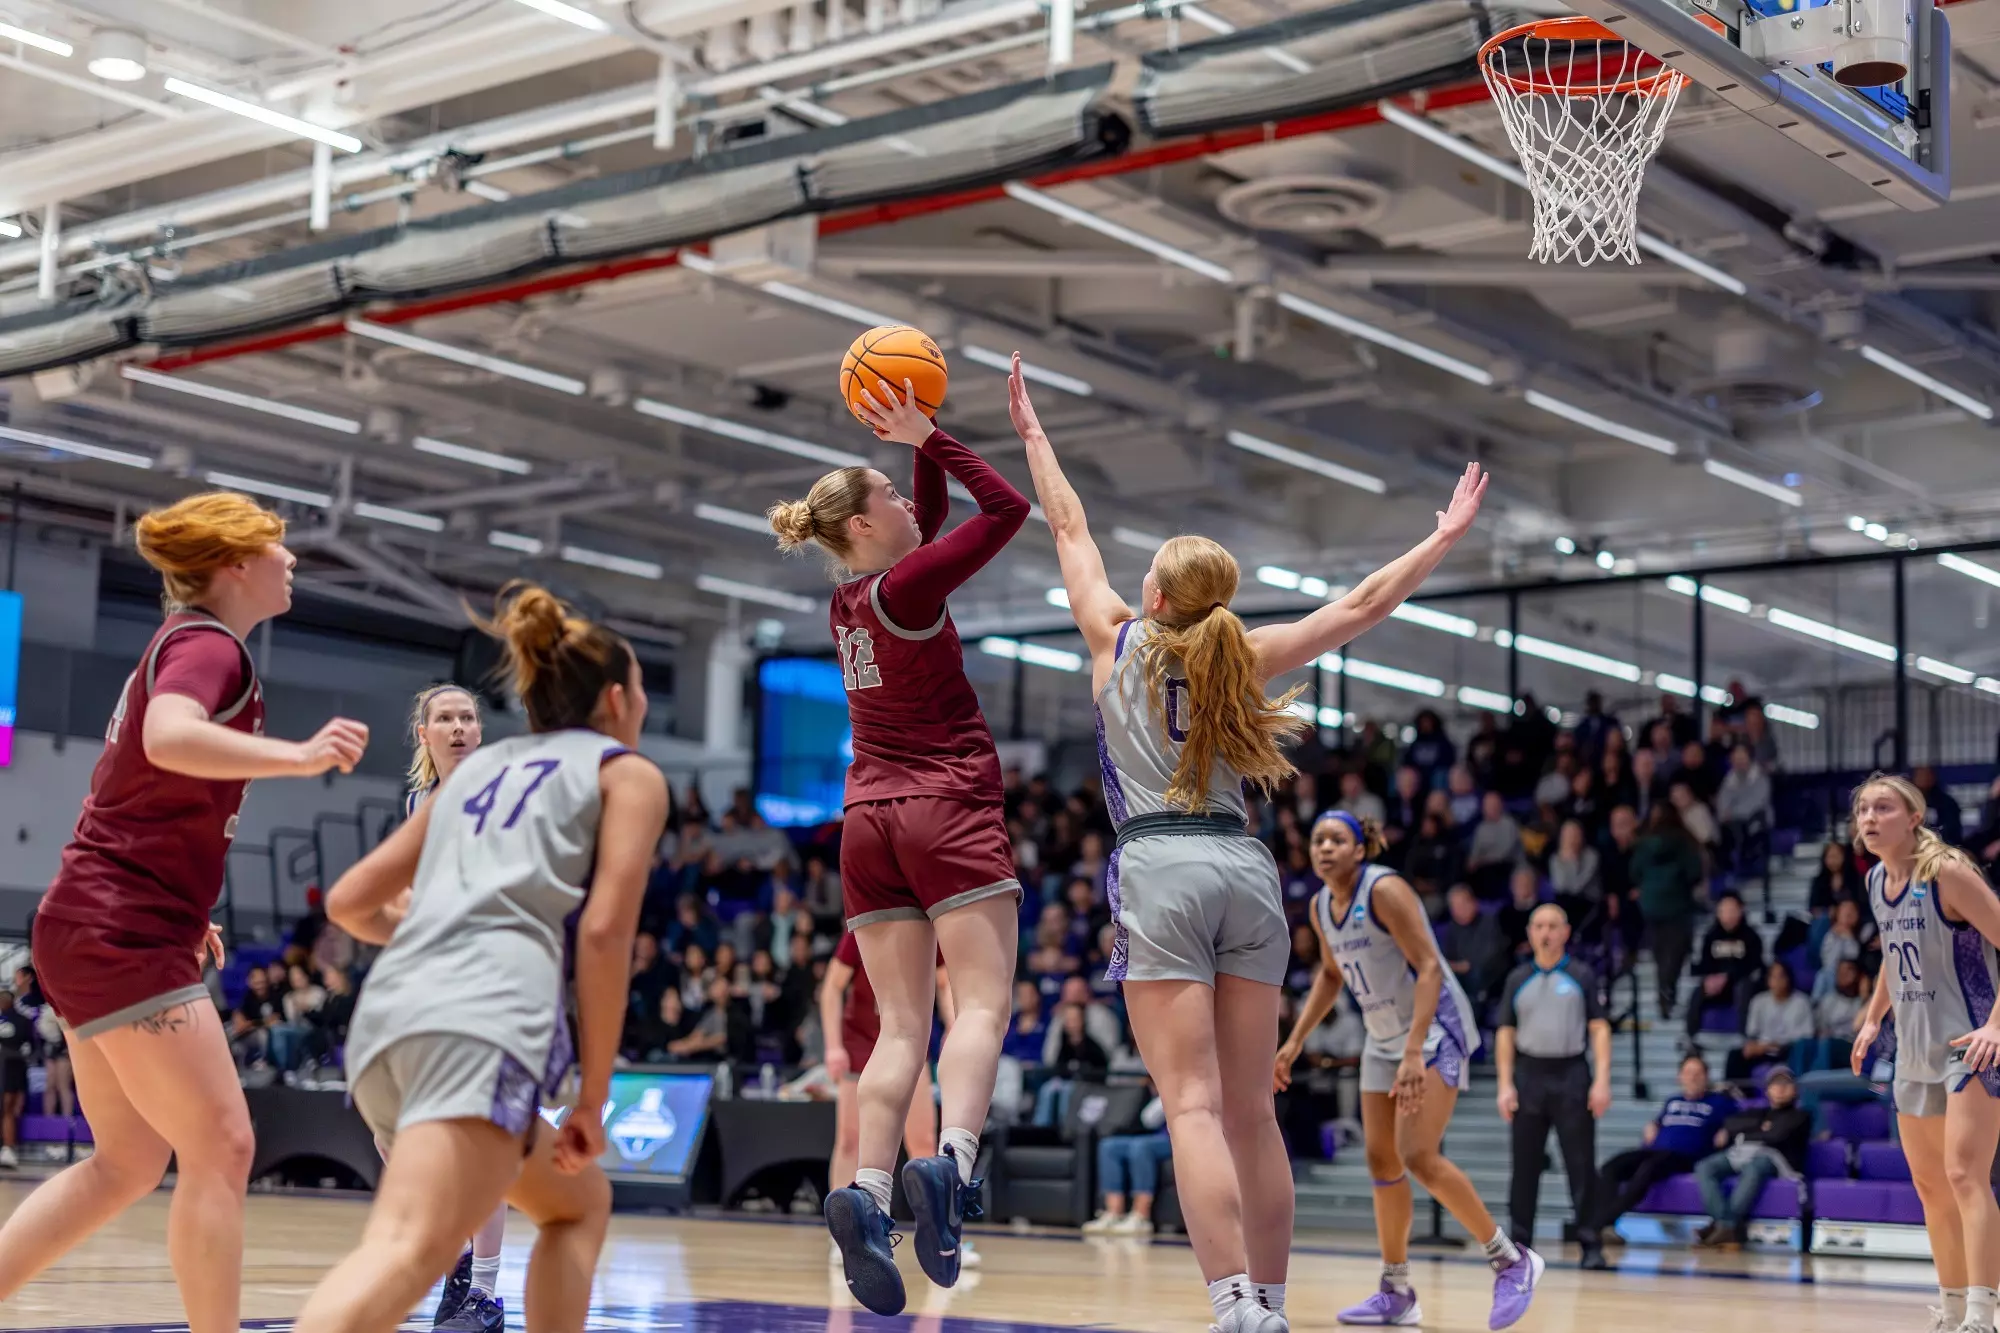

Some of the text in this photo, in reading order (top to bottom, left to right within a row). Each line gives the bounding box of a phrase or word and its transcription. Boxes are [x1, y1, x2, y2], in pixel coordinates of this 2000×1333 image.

[836, 626, 883, 691] 12
[463, 760, 560, 836] 47
[1888, 941, 1922, 983] 20
